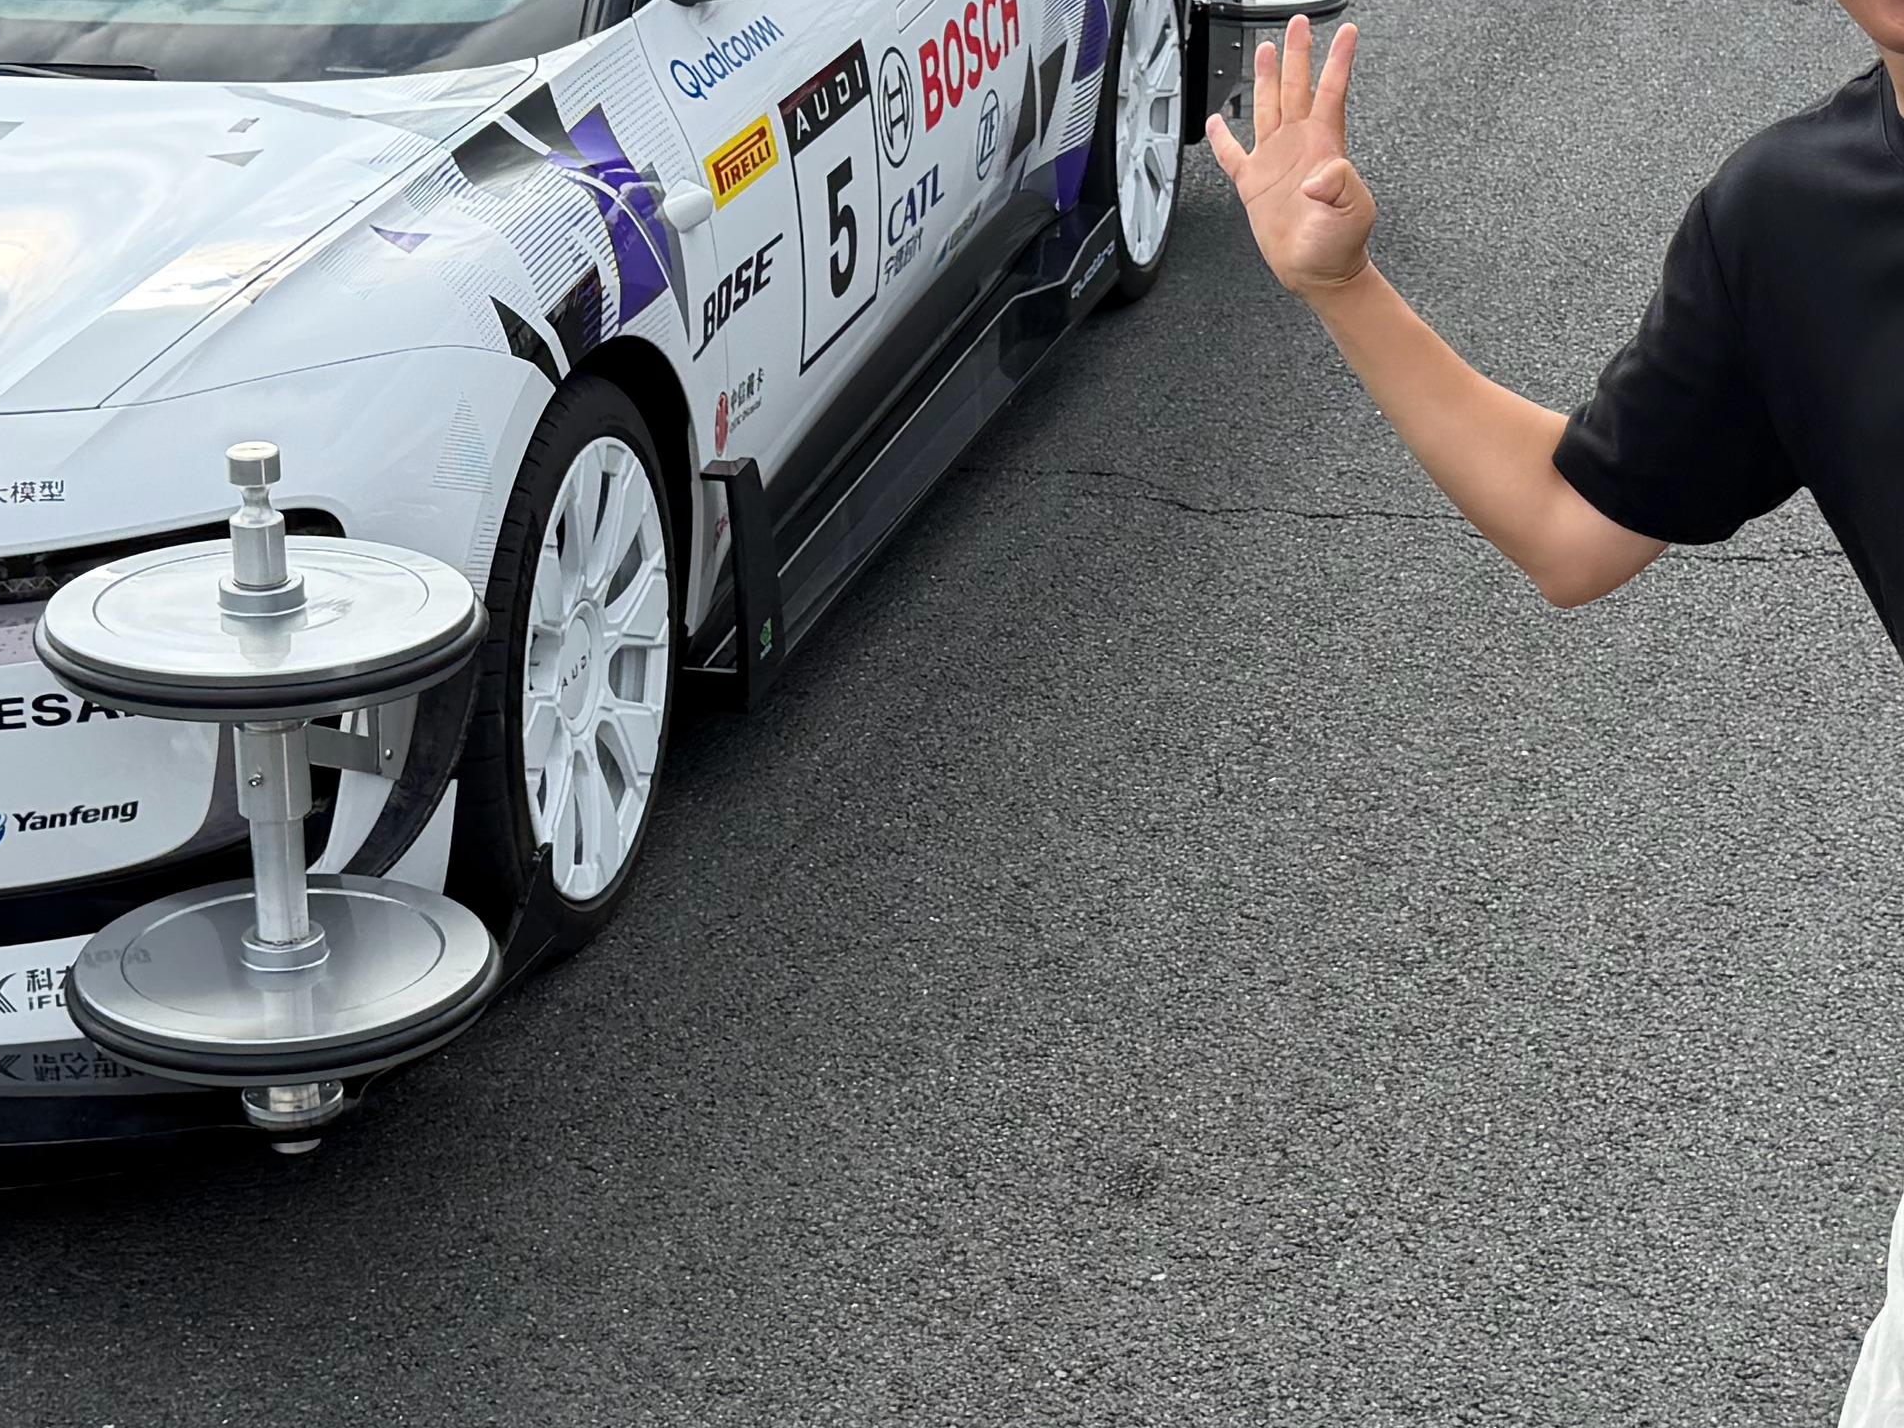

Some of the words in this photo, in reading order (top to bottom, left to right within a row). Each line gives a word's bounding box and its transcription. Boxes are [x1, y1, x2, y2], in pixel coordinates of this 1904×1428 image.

[669, 15, 785, 101] Qualcomm
[796, 59, 864, 141] AUDI
[711, 124, 772, 196] PIRELLI
[826, 156, 858, 299] 5
[887, 163, 945, 247] CATL
[692, 232, 784, 363] BOSE
[12, 800, 139, 832] Yanfeng
